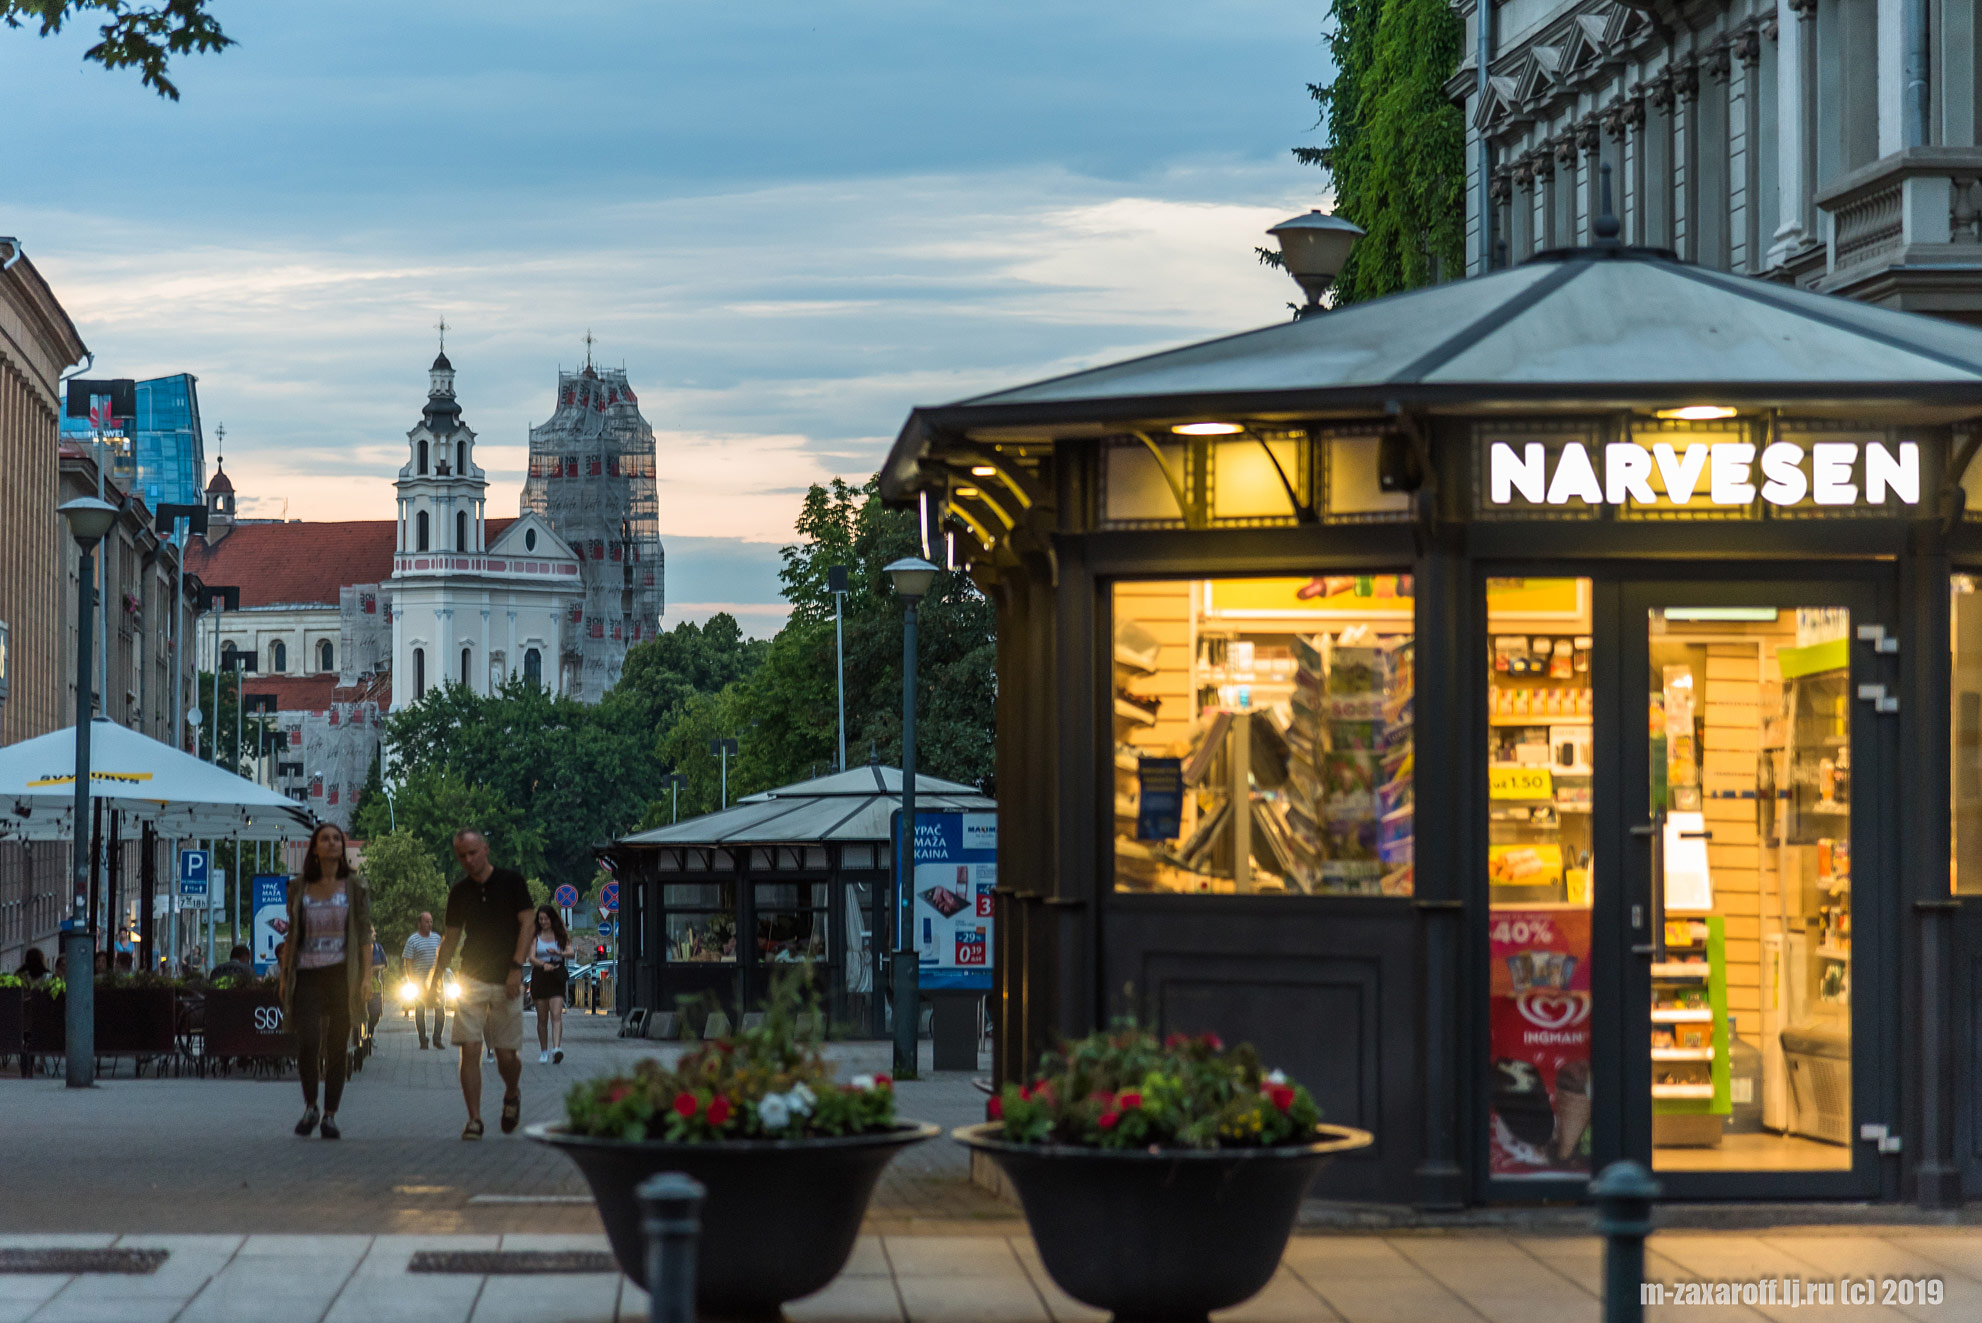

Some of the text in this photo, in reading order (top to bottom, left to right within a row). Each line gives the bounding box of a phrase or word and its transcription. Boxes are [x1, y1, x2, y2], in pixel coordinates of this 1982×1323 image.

[1490, 441, 1921, 506] NARVESEN
[1511, 776, 1543, 789] 1.50
[914, 849, 949, 859] KAINA
[188, 853, 203, 877] P
[980, 897, 991, 915] 3
[1523, 1031, 1583, 1045] INGMAN
